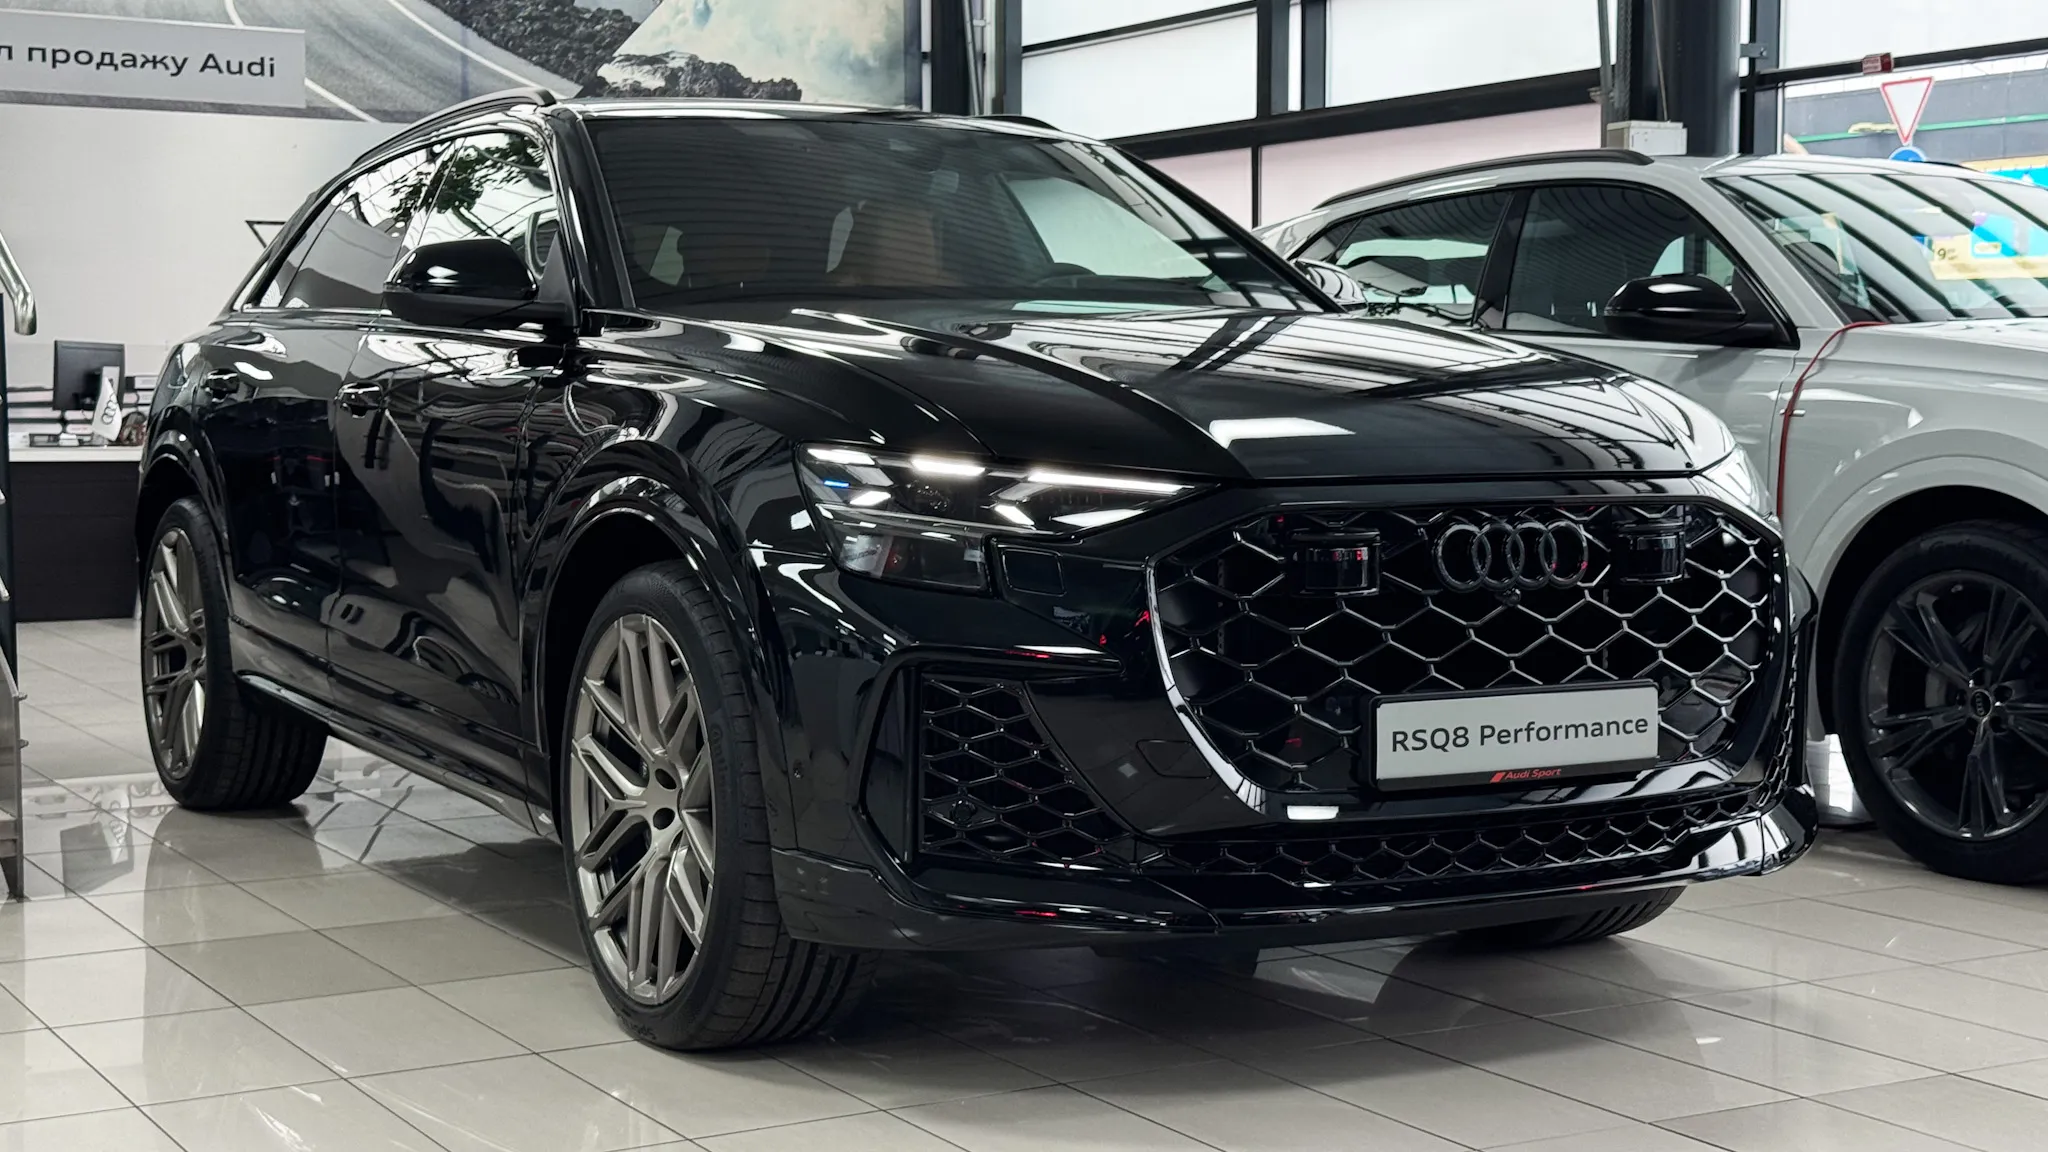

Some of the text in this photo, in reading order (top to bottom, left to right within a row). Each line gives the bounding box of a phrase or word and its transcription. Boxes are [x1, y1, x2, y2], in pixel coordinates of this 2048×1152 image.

[27, 46, 189, 77] продажу
[199, 53, 275, 78] Audi
[1392, 718, 1648, 752] RSQ8 Performance
[1505, 768, 1562, 780] Audi Sport
